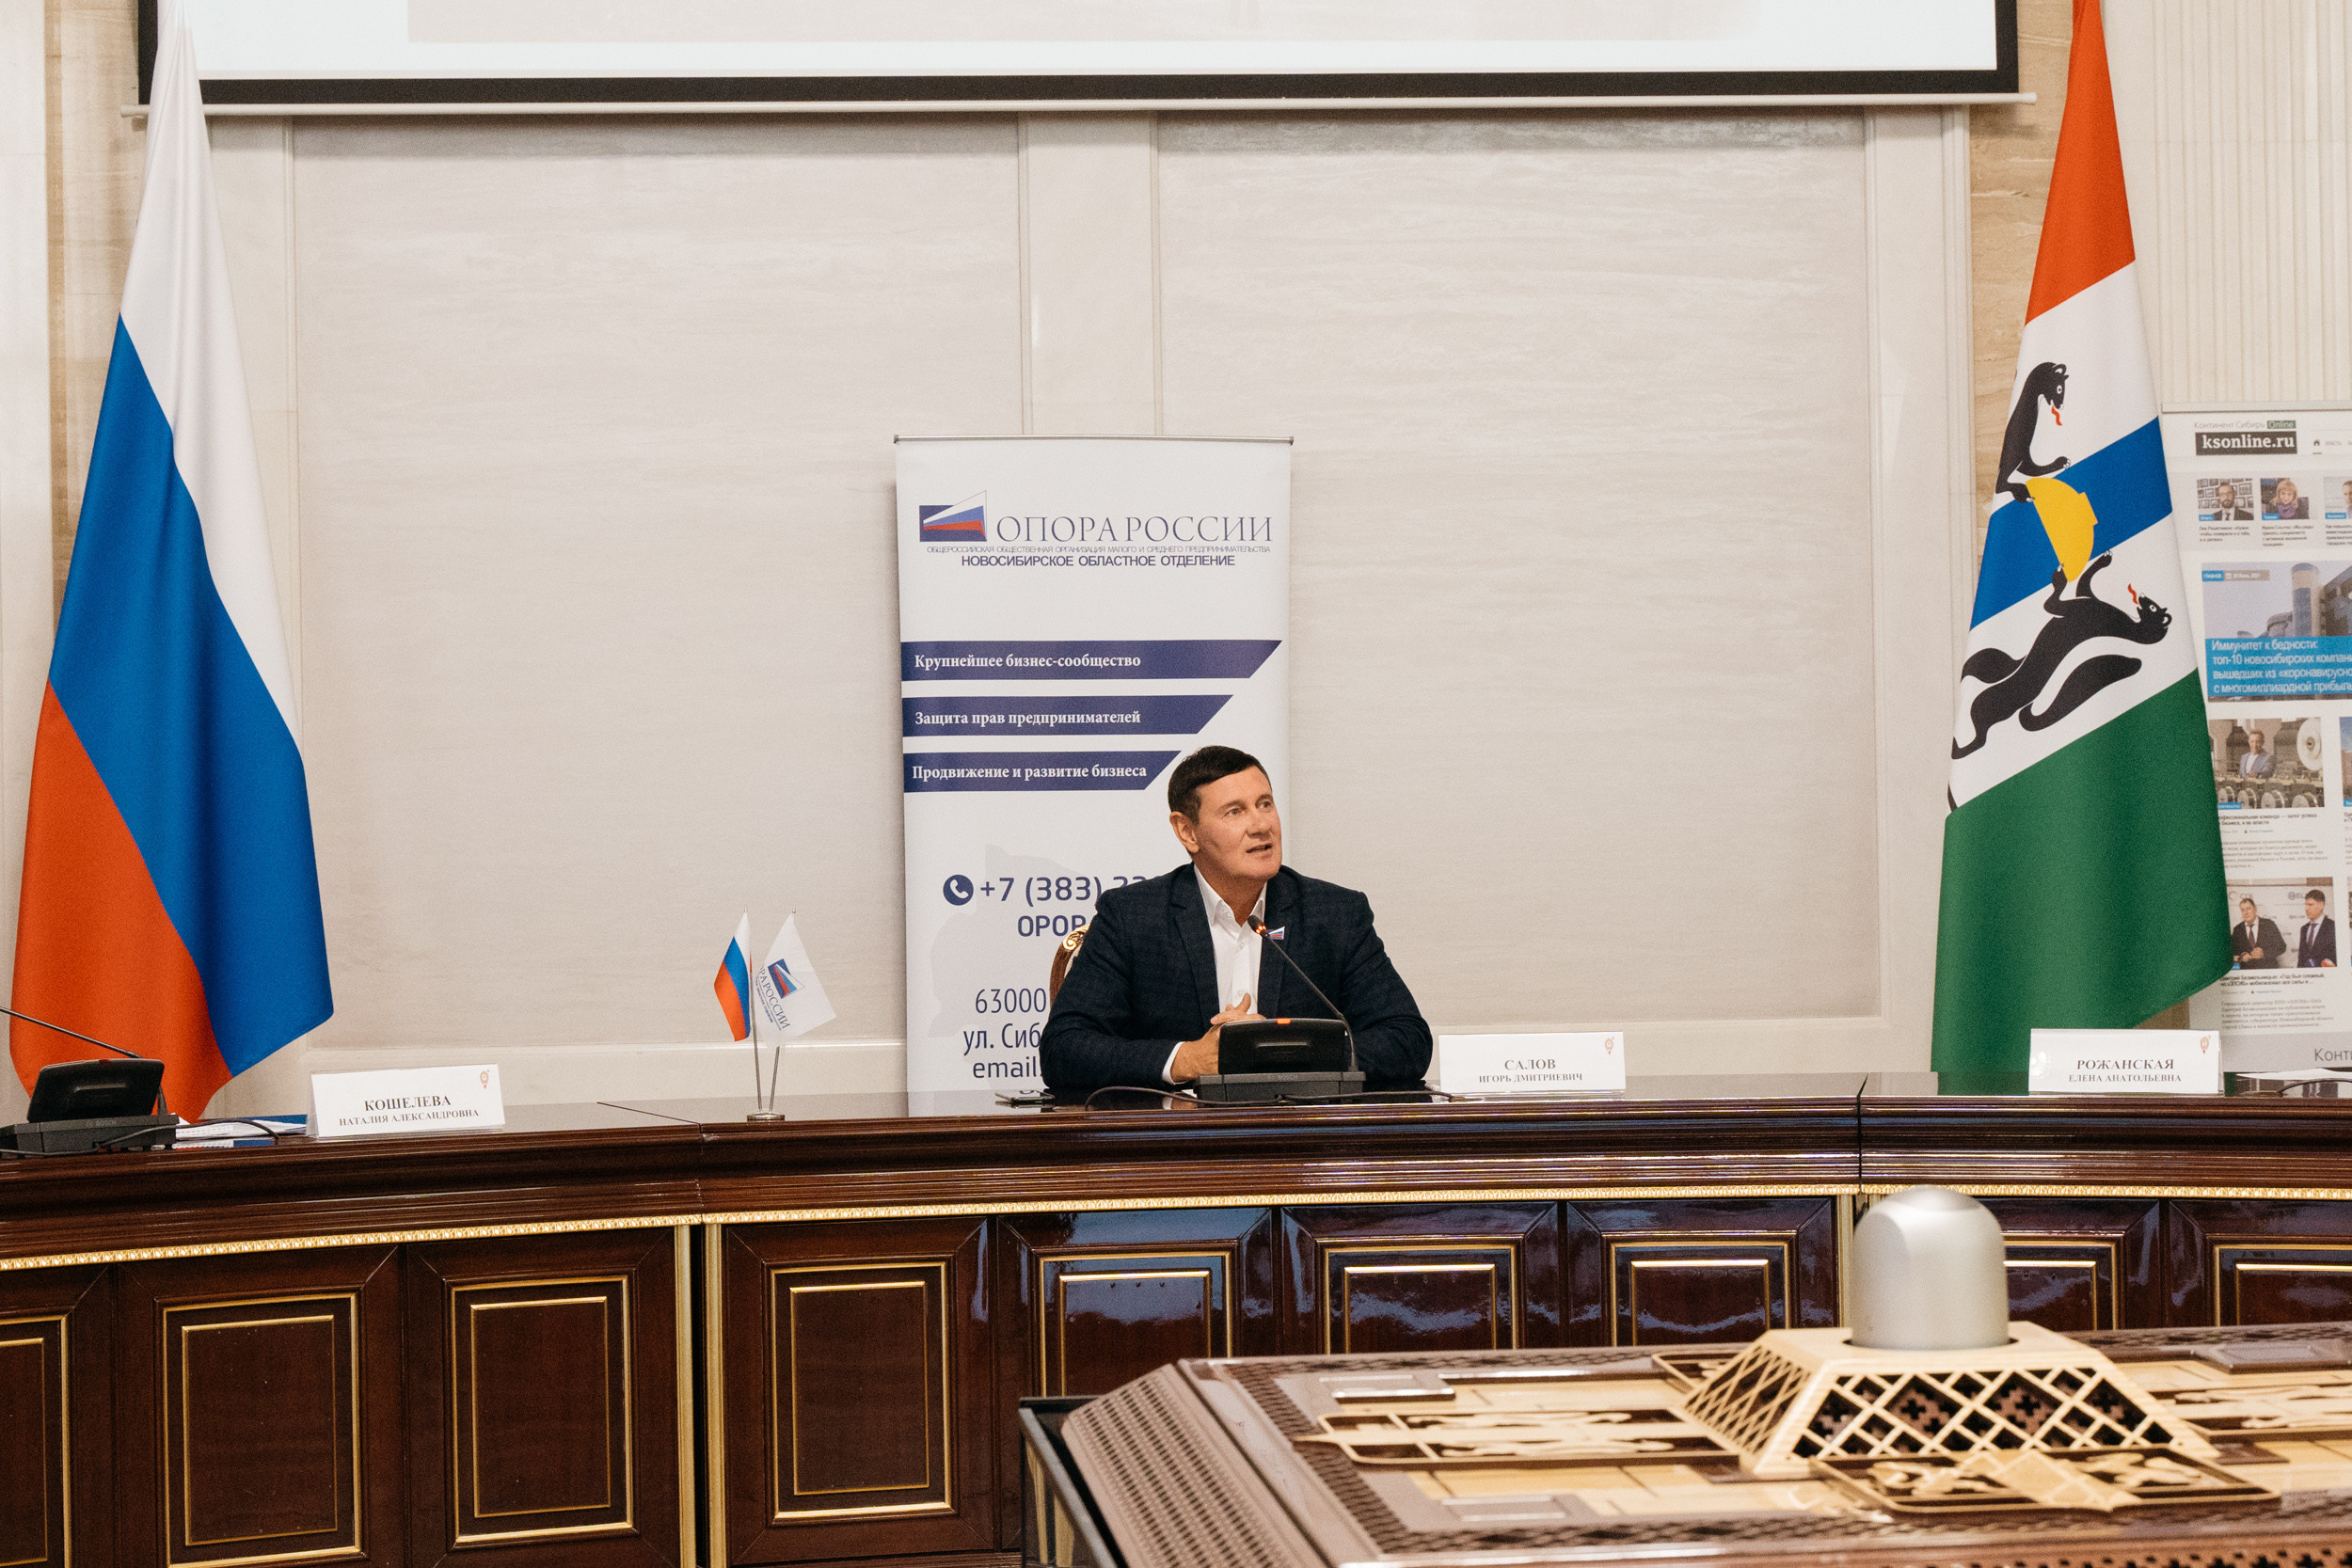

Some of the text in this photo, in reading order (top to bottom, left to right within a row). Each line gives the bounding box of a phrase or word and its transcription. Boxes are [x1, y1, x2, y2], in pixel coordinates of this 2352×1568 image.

[2268, 420, 2295, 429] Online
[2202, 435, 2295, 449] ksonline.ru
[996, 516, 1273, 542] ОПОРА РОССИИ
[927, 546, 994, 554] ОБЩЕРОССИЙСКАЯ
[996, 546, 1053, 554] ОБЩЕСТВЕННАЯ
[1056, 546, 1106, 554] ОРГАНИЗАЦИЯ
[1146, 546, 1184, 554] СРЕДНЕГО
[1185, 546, 1270, 554] ПРЕДПРИНИМАТЕЛЬСТВА
[961, 555, 1235, 567] НОВОСИБИРСКОЕ ОБЛАСТНОЕ ОТДЕЛЕНИЕ
[2211, 639, 2318, 653] Иммунитет к бедности:
[914, 654, 1141, 671] Крупнейшее бизнес-сообщество
[2213, 654, 2242, 665] топ-10
[2244, 653, 2314, 666] новосибирских
[2213, 671, 2263, 680] вышедших
[2265, 670, 2276, 678] из
[2214, 685, 2219, 693] с
[2221, 681, 2312, 694] многомиллиардной
[914, 710, 1141, 727] Защита прав предпринимателей
[913, 763, 1147, 783] Продвижение и развитие бизнеса
[980, 877, 1015, 902] +7
[1025, 877, 1103, 907] (383)
[759, 965, 768, 983] РА
[763, 982, 790, 1029] РОССИИ
[976, 988, 1046, 1013] 63000
[963, 1031, 993, 1056] ул.
[1504, 1059, 1556, 1070] САЛОВ
[2076, 1059, 2174, 1069] РОЖАНСКАЯ
[1514, 1073, 1582, 1083] ДМИТРИЕВИЧ
[364, 1095, 452, 1111] КОШЕЛЕВА
[340, 1109, 479, 1127] НАТАЛИЯ АЛЕКСАНДРОВНА
